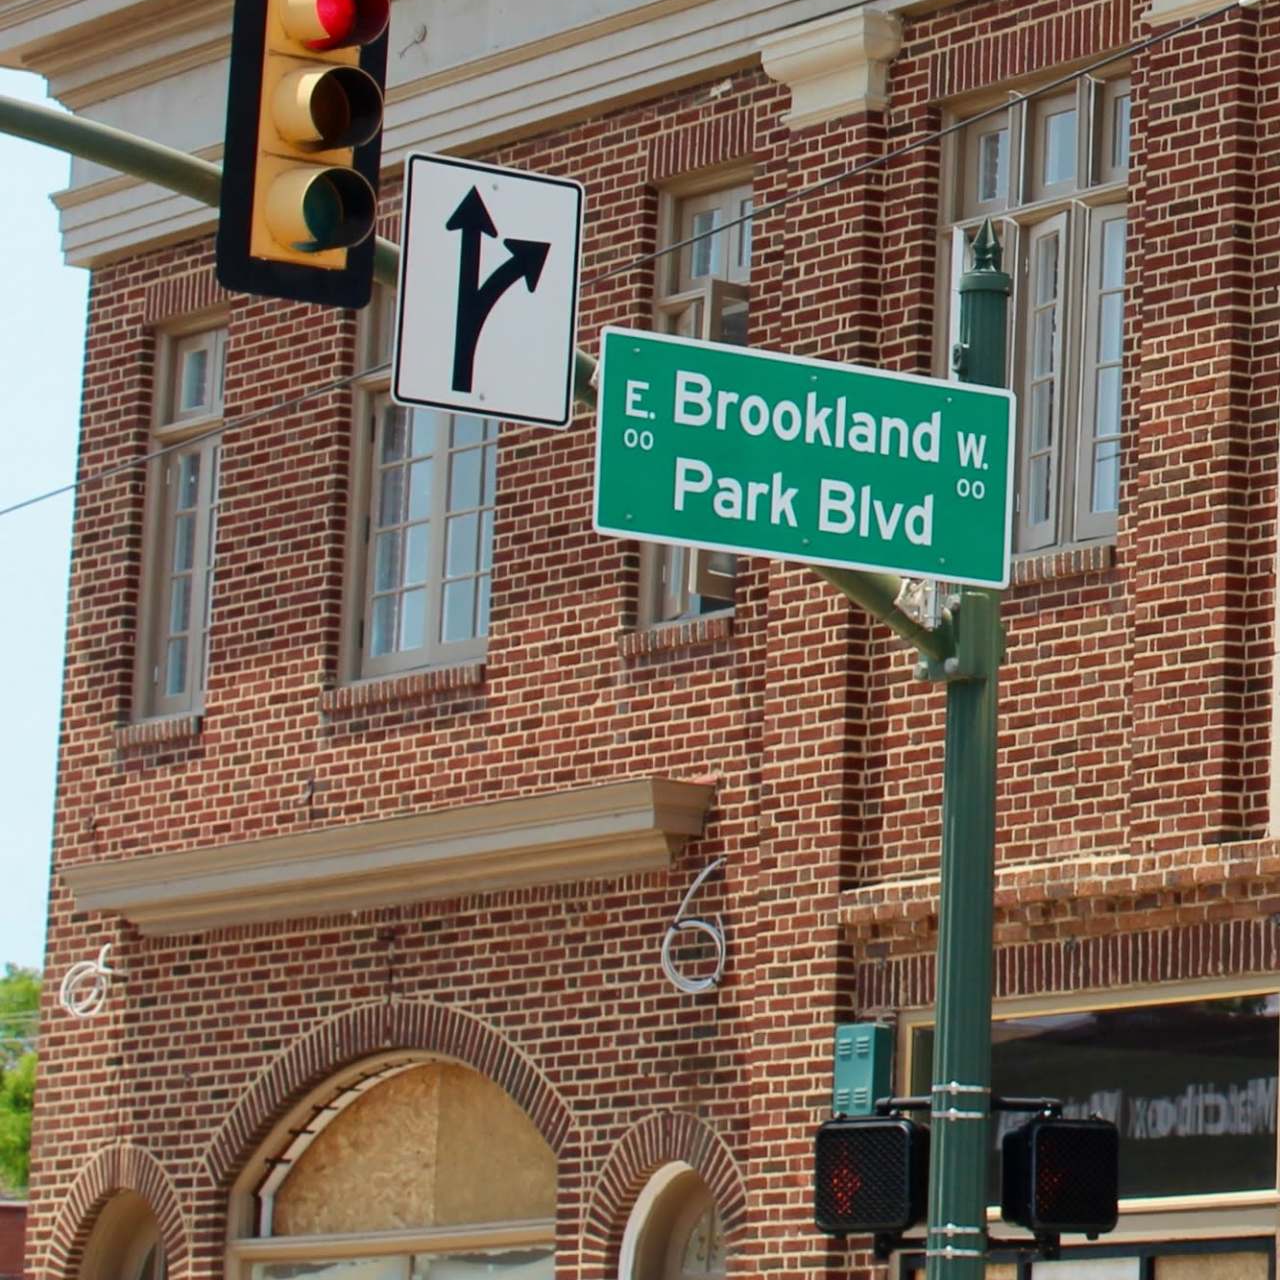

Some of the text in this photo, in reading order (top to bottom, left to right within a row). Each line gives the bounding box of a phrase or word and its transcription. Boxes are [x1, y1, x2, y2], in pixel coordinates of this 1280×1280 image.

[624, 370, 989, 471] E. Brookland W.
[673, 457, 935, 546] Park Blvd
